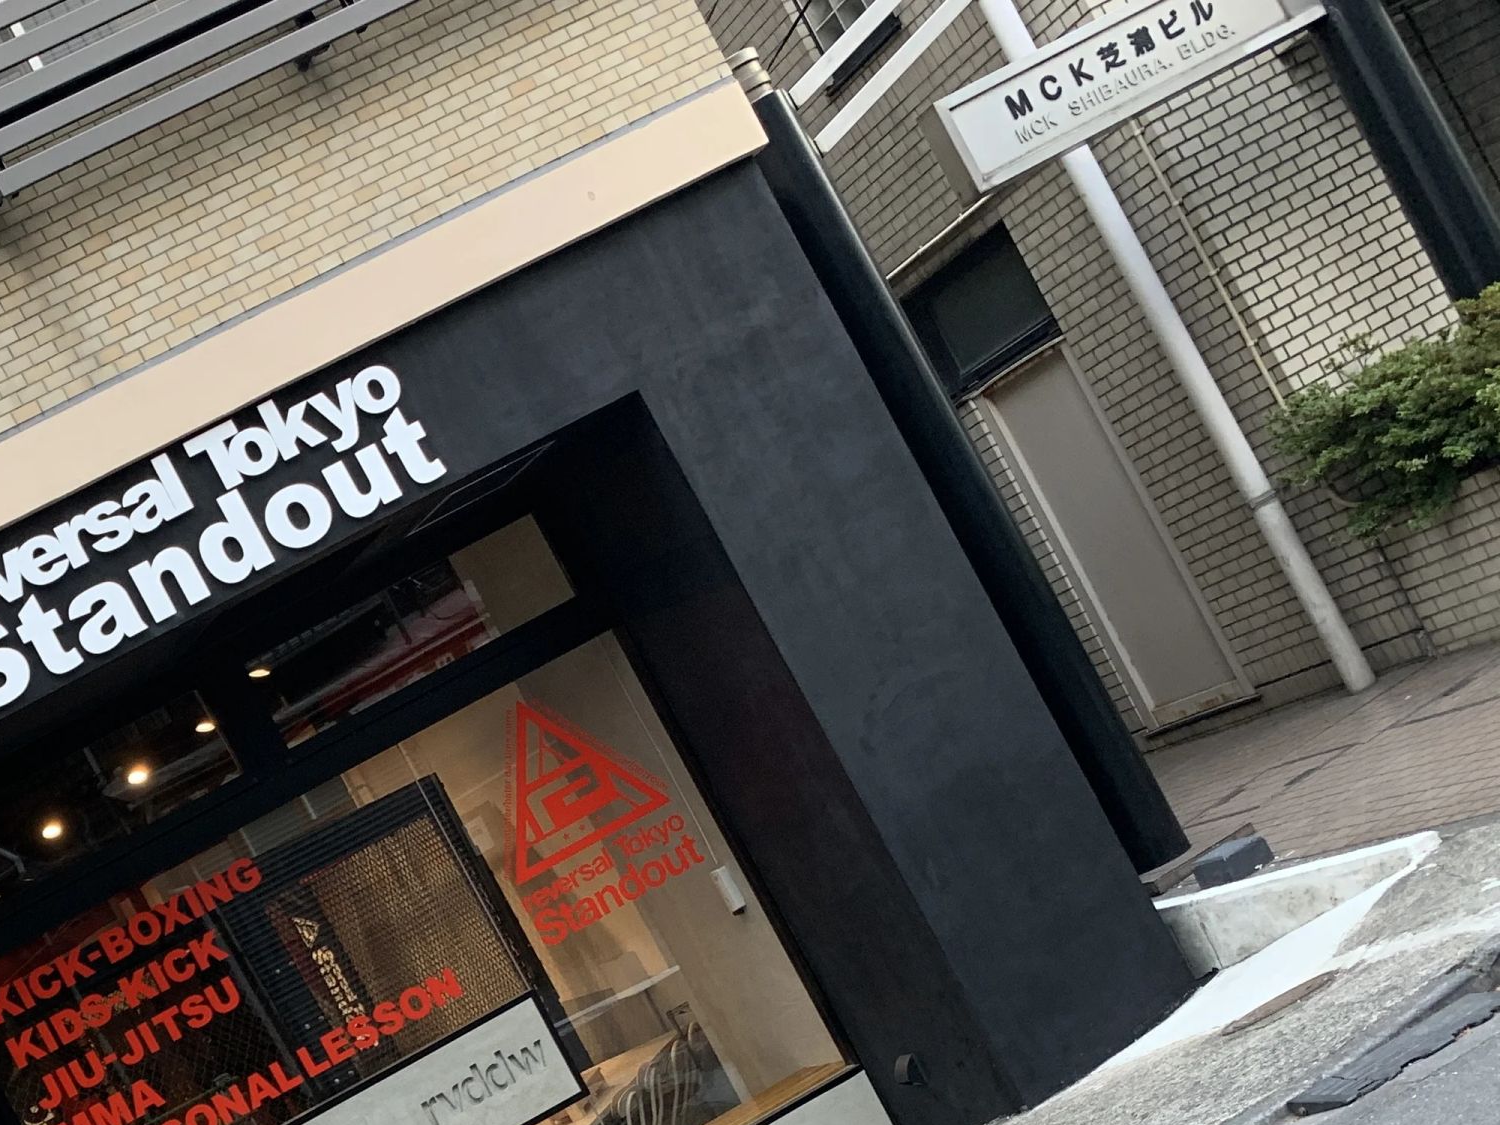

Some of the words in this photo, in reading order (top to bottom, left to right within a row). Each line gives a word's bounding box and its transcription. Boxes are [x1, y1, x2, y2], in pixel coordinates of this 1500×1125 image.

[1014, 114, 1058, 144] MCK
[1175, 24, 1236, 60] BLDG.
[182, 365, 401, 490] Tokyo
[522, 848, 613, 911] reversal
[612, 814, 685, 859] Tokyo
[533, 833, 705, 946] Standout
[4, 929, 234, 1069] KIDS-KICK
[37, 977, 242, 1111] JIU-JITSU
[298, 967, 464, 1079] LESSON
